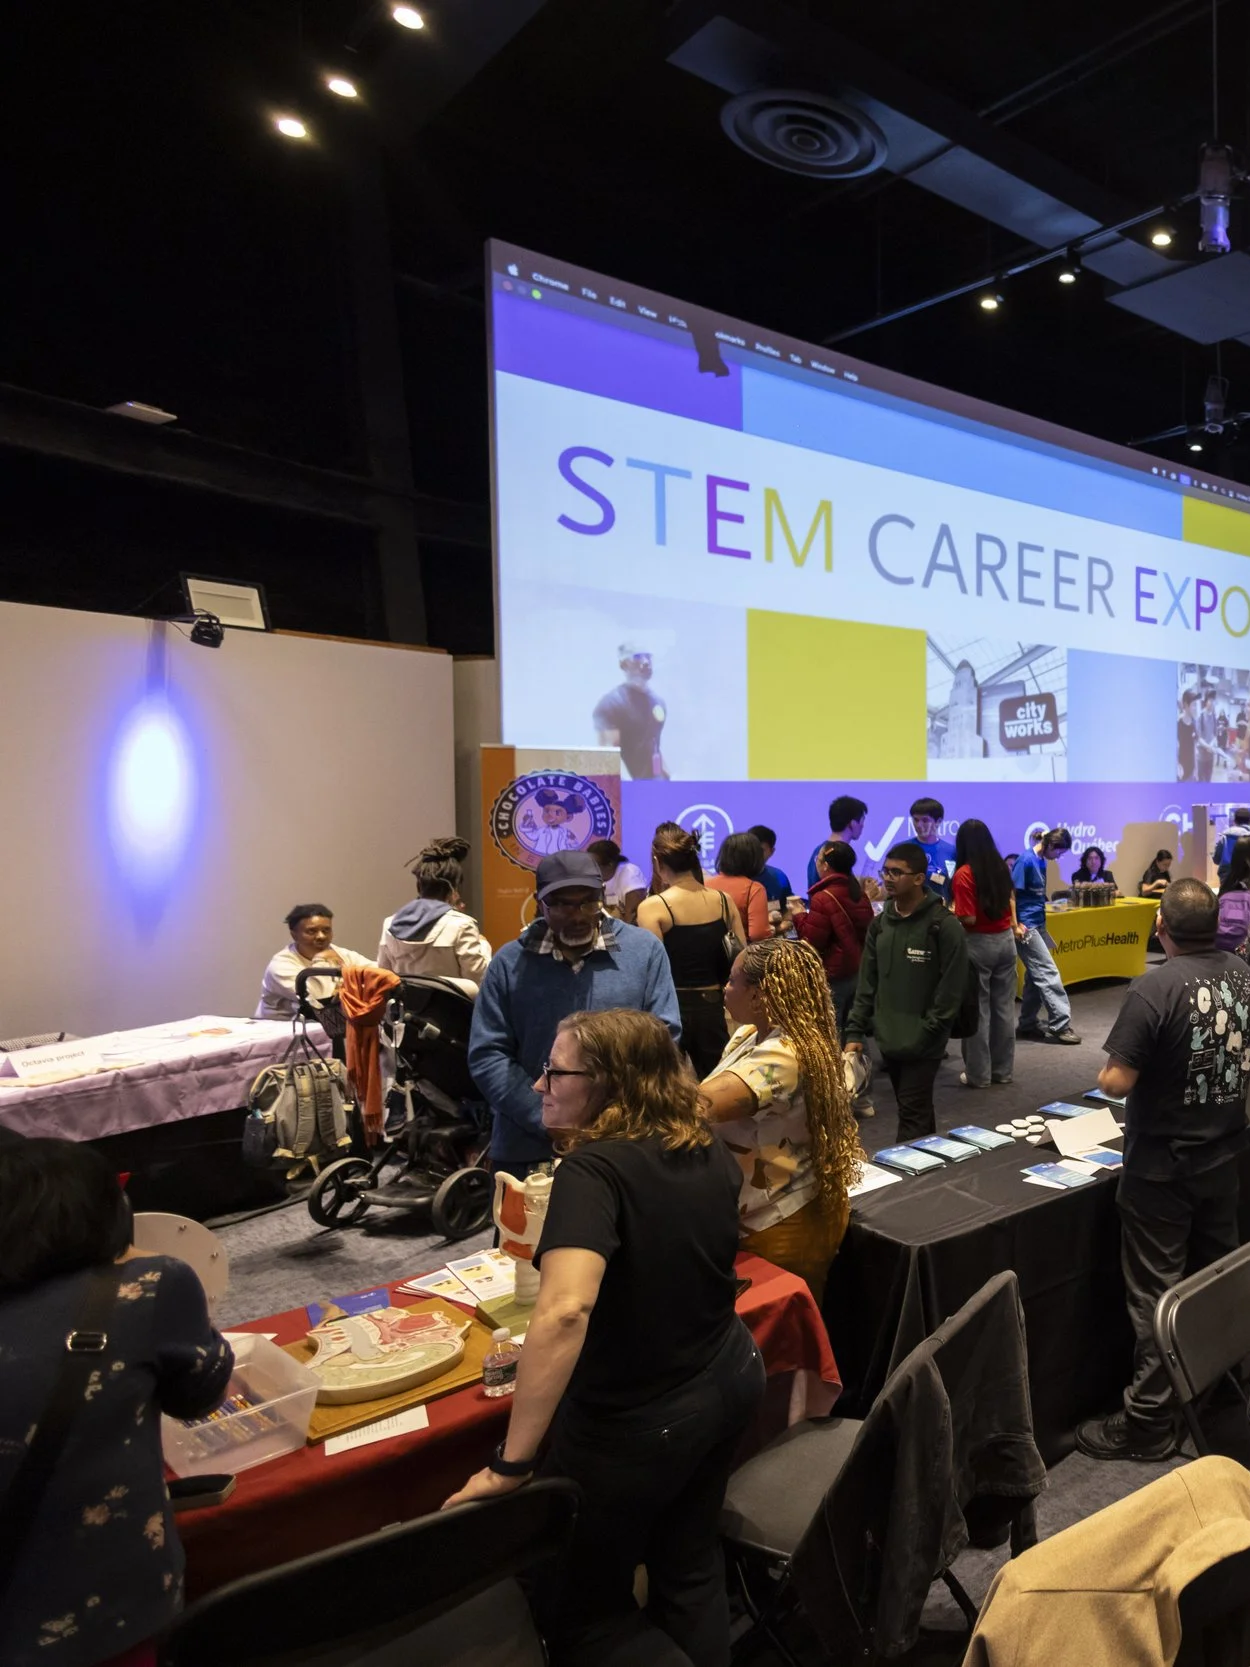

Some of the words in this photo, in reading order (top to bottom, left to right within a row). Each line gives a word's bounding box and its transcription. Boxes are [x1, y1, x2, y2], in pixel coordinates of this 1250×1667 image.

[532, 272, 569, 291] Chrome
[581, 287, 598, 300] File
[609, 296, 626, 309] Edit
[638, 306, 657, 319] View
[811, 360, 836, 375] Window
[557, 445, 833, 573] STEM
[867, 513, 1116, 618] CAREER
[1016, 701, 1046, 722] city
[1004, 719, 1053, 738] works
[498, 776, 566, 830] CHOCOLATE
[573, 781, 607, 829] BABIES
[1053, 931, 1139, 956] MetroPlusHealth
[56, 1050, 86, 1063] project
